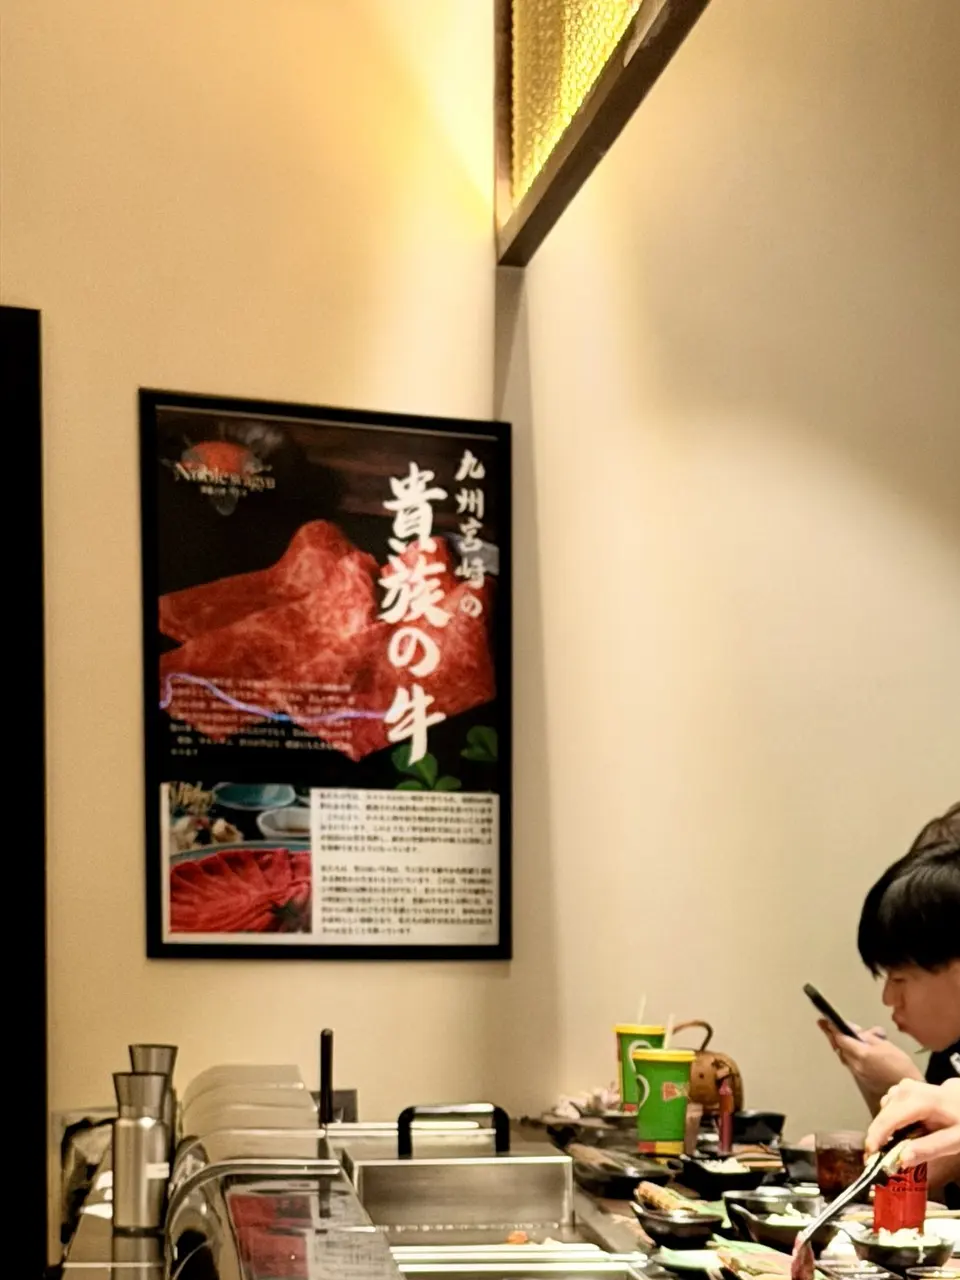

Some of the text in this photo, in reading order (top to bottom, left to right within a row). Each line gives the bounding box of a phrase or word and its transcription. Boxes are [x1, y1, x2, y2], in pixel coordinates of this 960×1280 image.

[378, 460, 454, 767] 貴族の牛
[454, 448, 486, 618] 九州宮崎の
